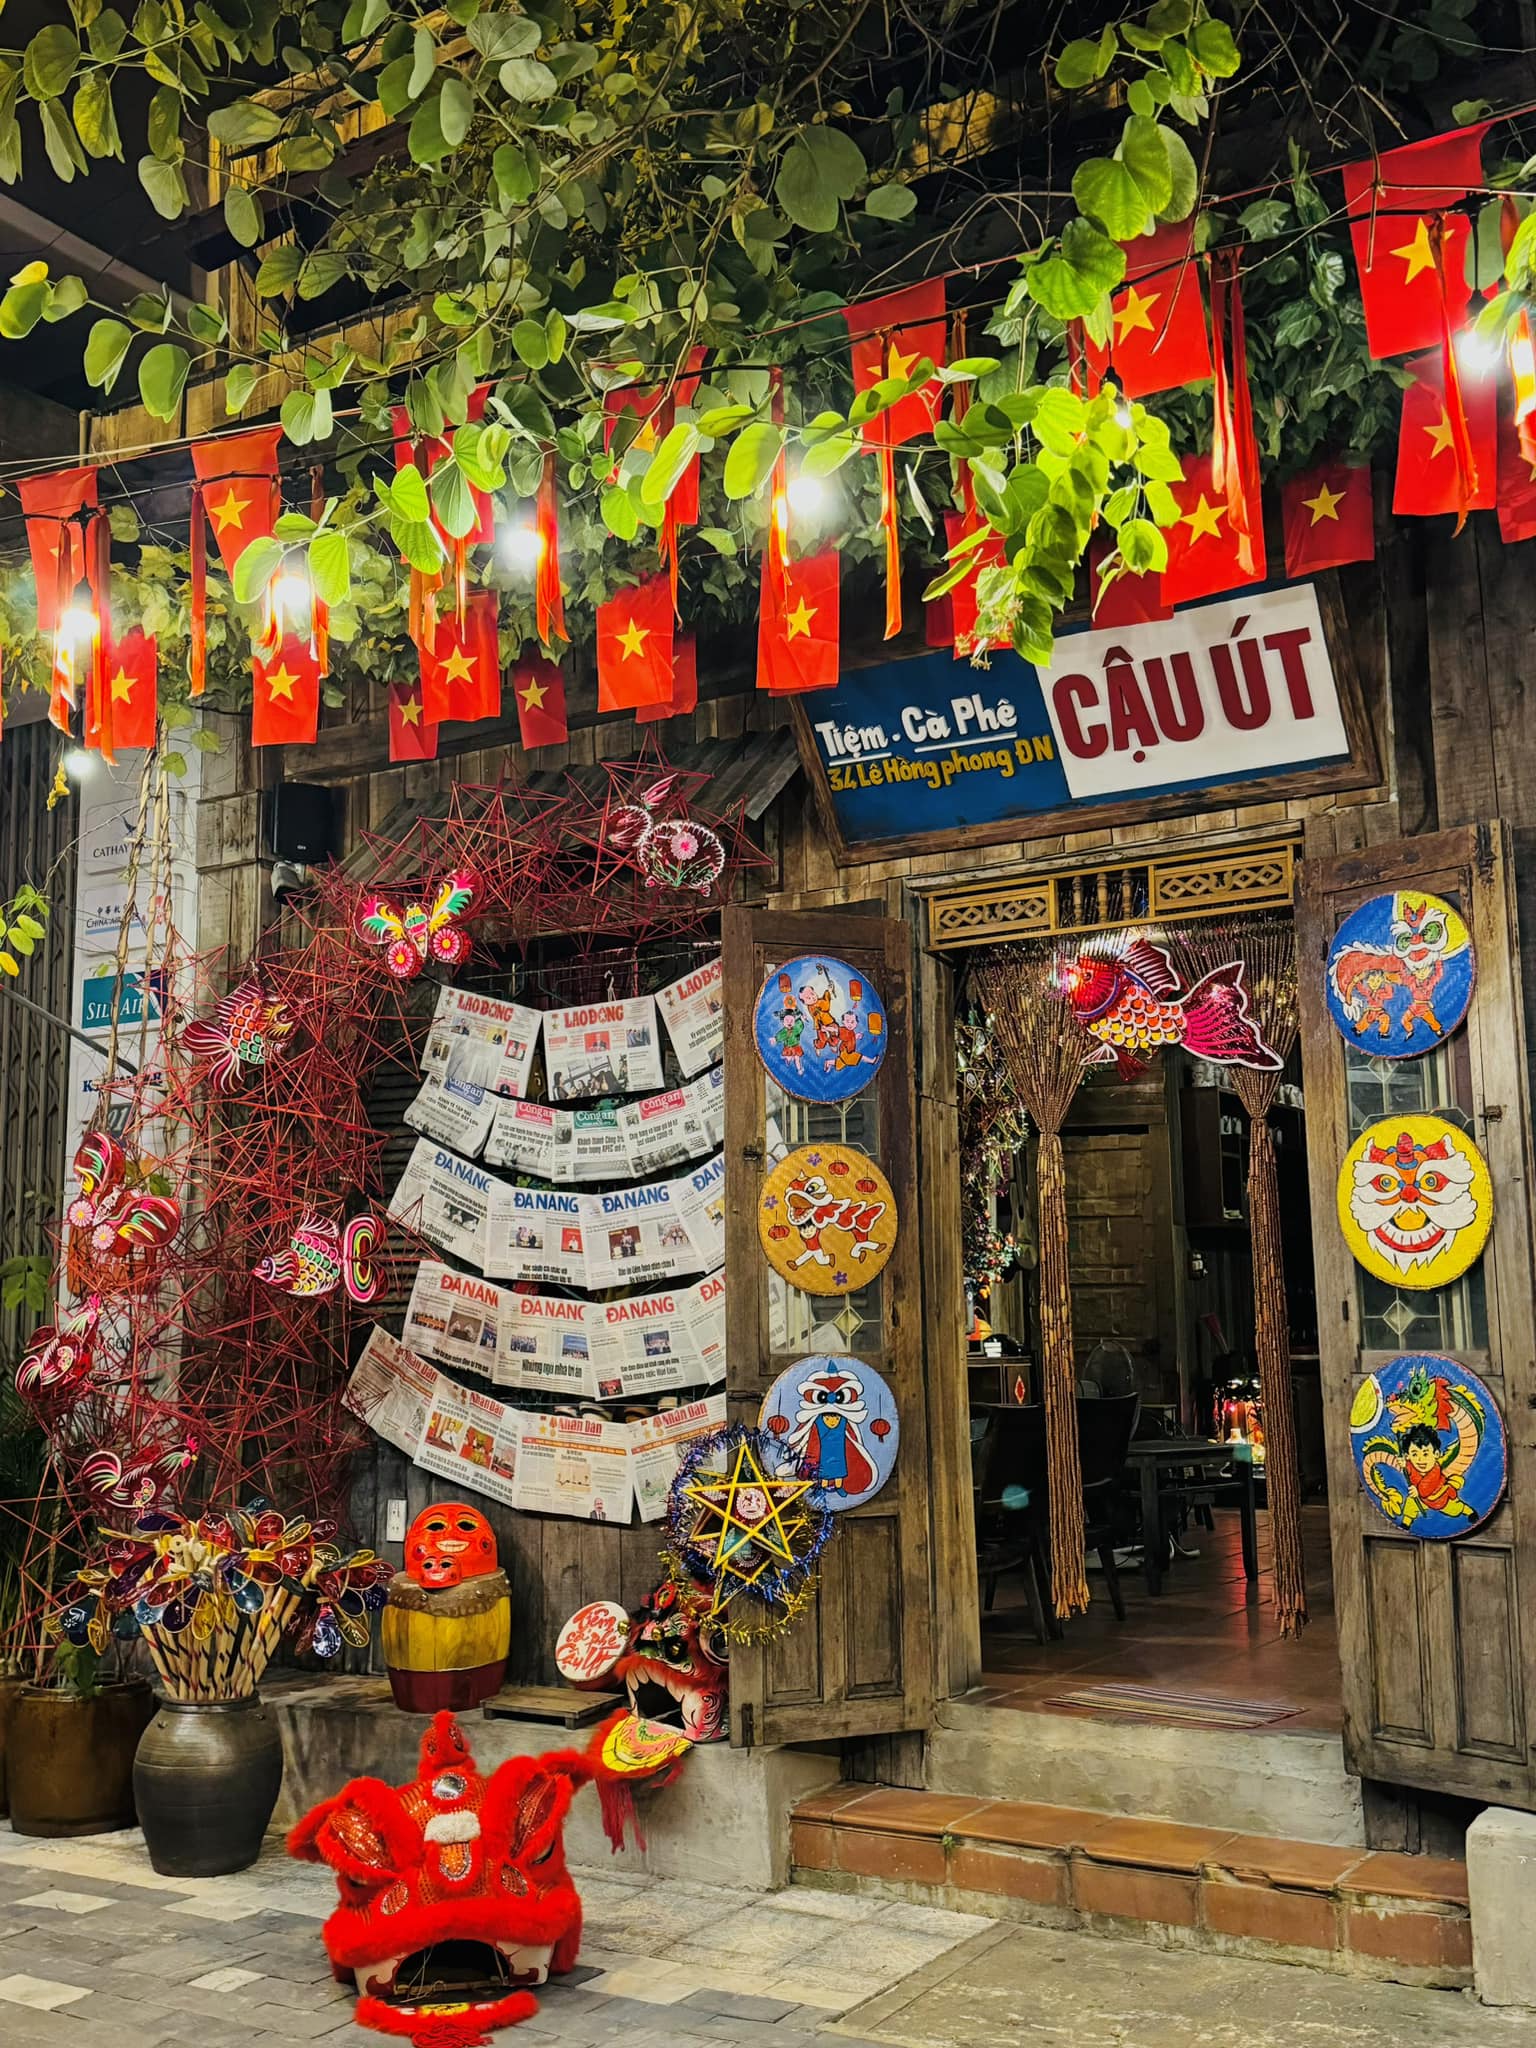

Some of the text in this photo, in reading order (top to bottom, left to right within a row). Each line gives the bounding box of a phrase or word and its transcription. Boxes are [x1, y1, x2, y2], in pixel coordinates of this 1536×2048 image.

[1052, 614, 1315, 763] CẬU ÚT
[901, 705, 951, 743] Cà
[951, 693, 1017, 735] Phê
[827, 766, 857, 792] 34
[856, 763, 884, 788] Lê
[882, 755, 941, 790] Hồng
[93, 843, 128, 858] CATHAY
[457, 994, 479, 1013] LAO
[564, 1010, 589, 1028] LAO
